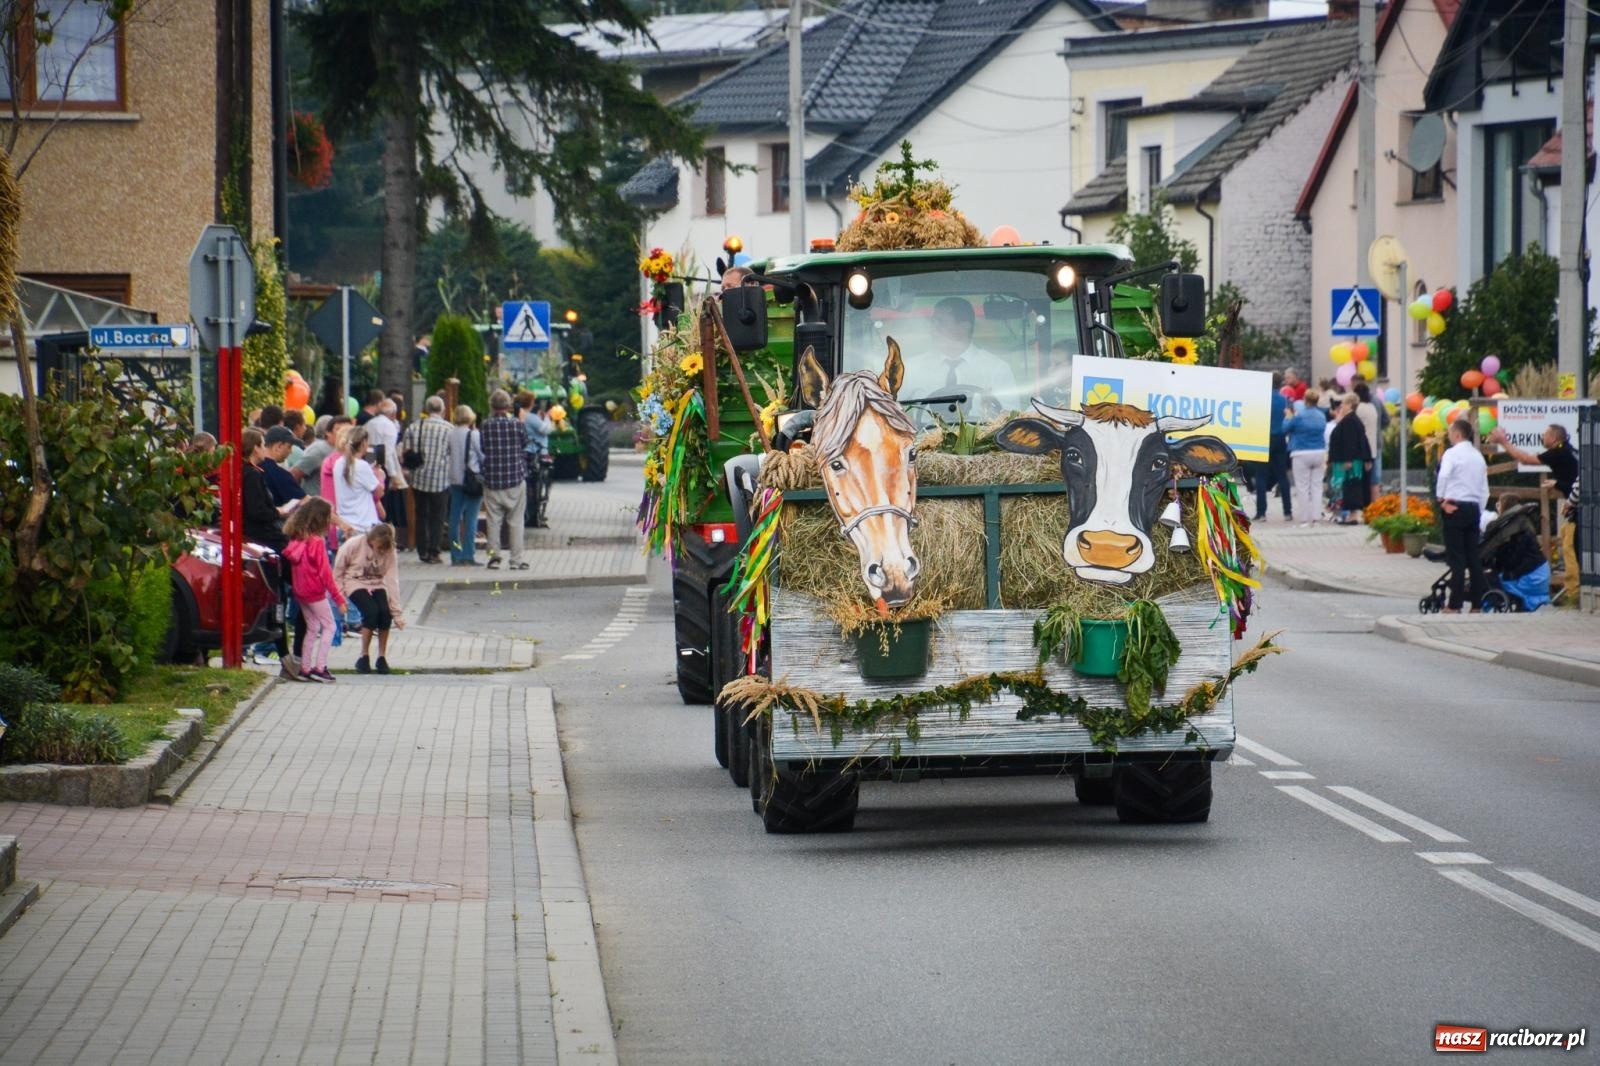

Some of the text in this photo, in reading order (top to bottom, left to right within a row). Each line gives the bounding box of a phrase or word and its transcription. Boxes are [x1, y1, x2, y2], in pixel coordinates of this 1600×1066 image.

[1147, 392, 1243, 429] KORNICE
[1503, 403, 1579, 414] DOŻYNKI GMIN
[1505, 432, 1546, 447] PARKIN
